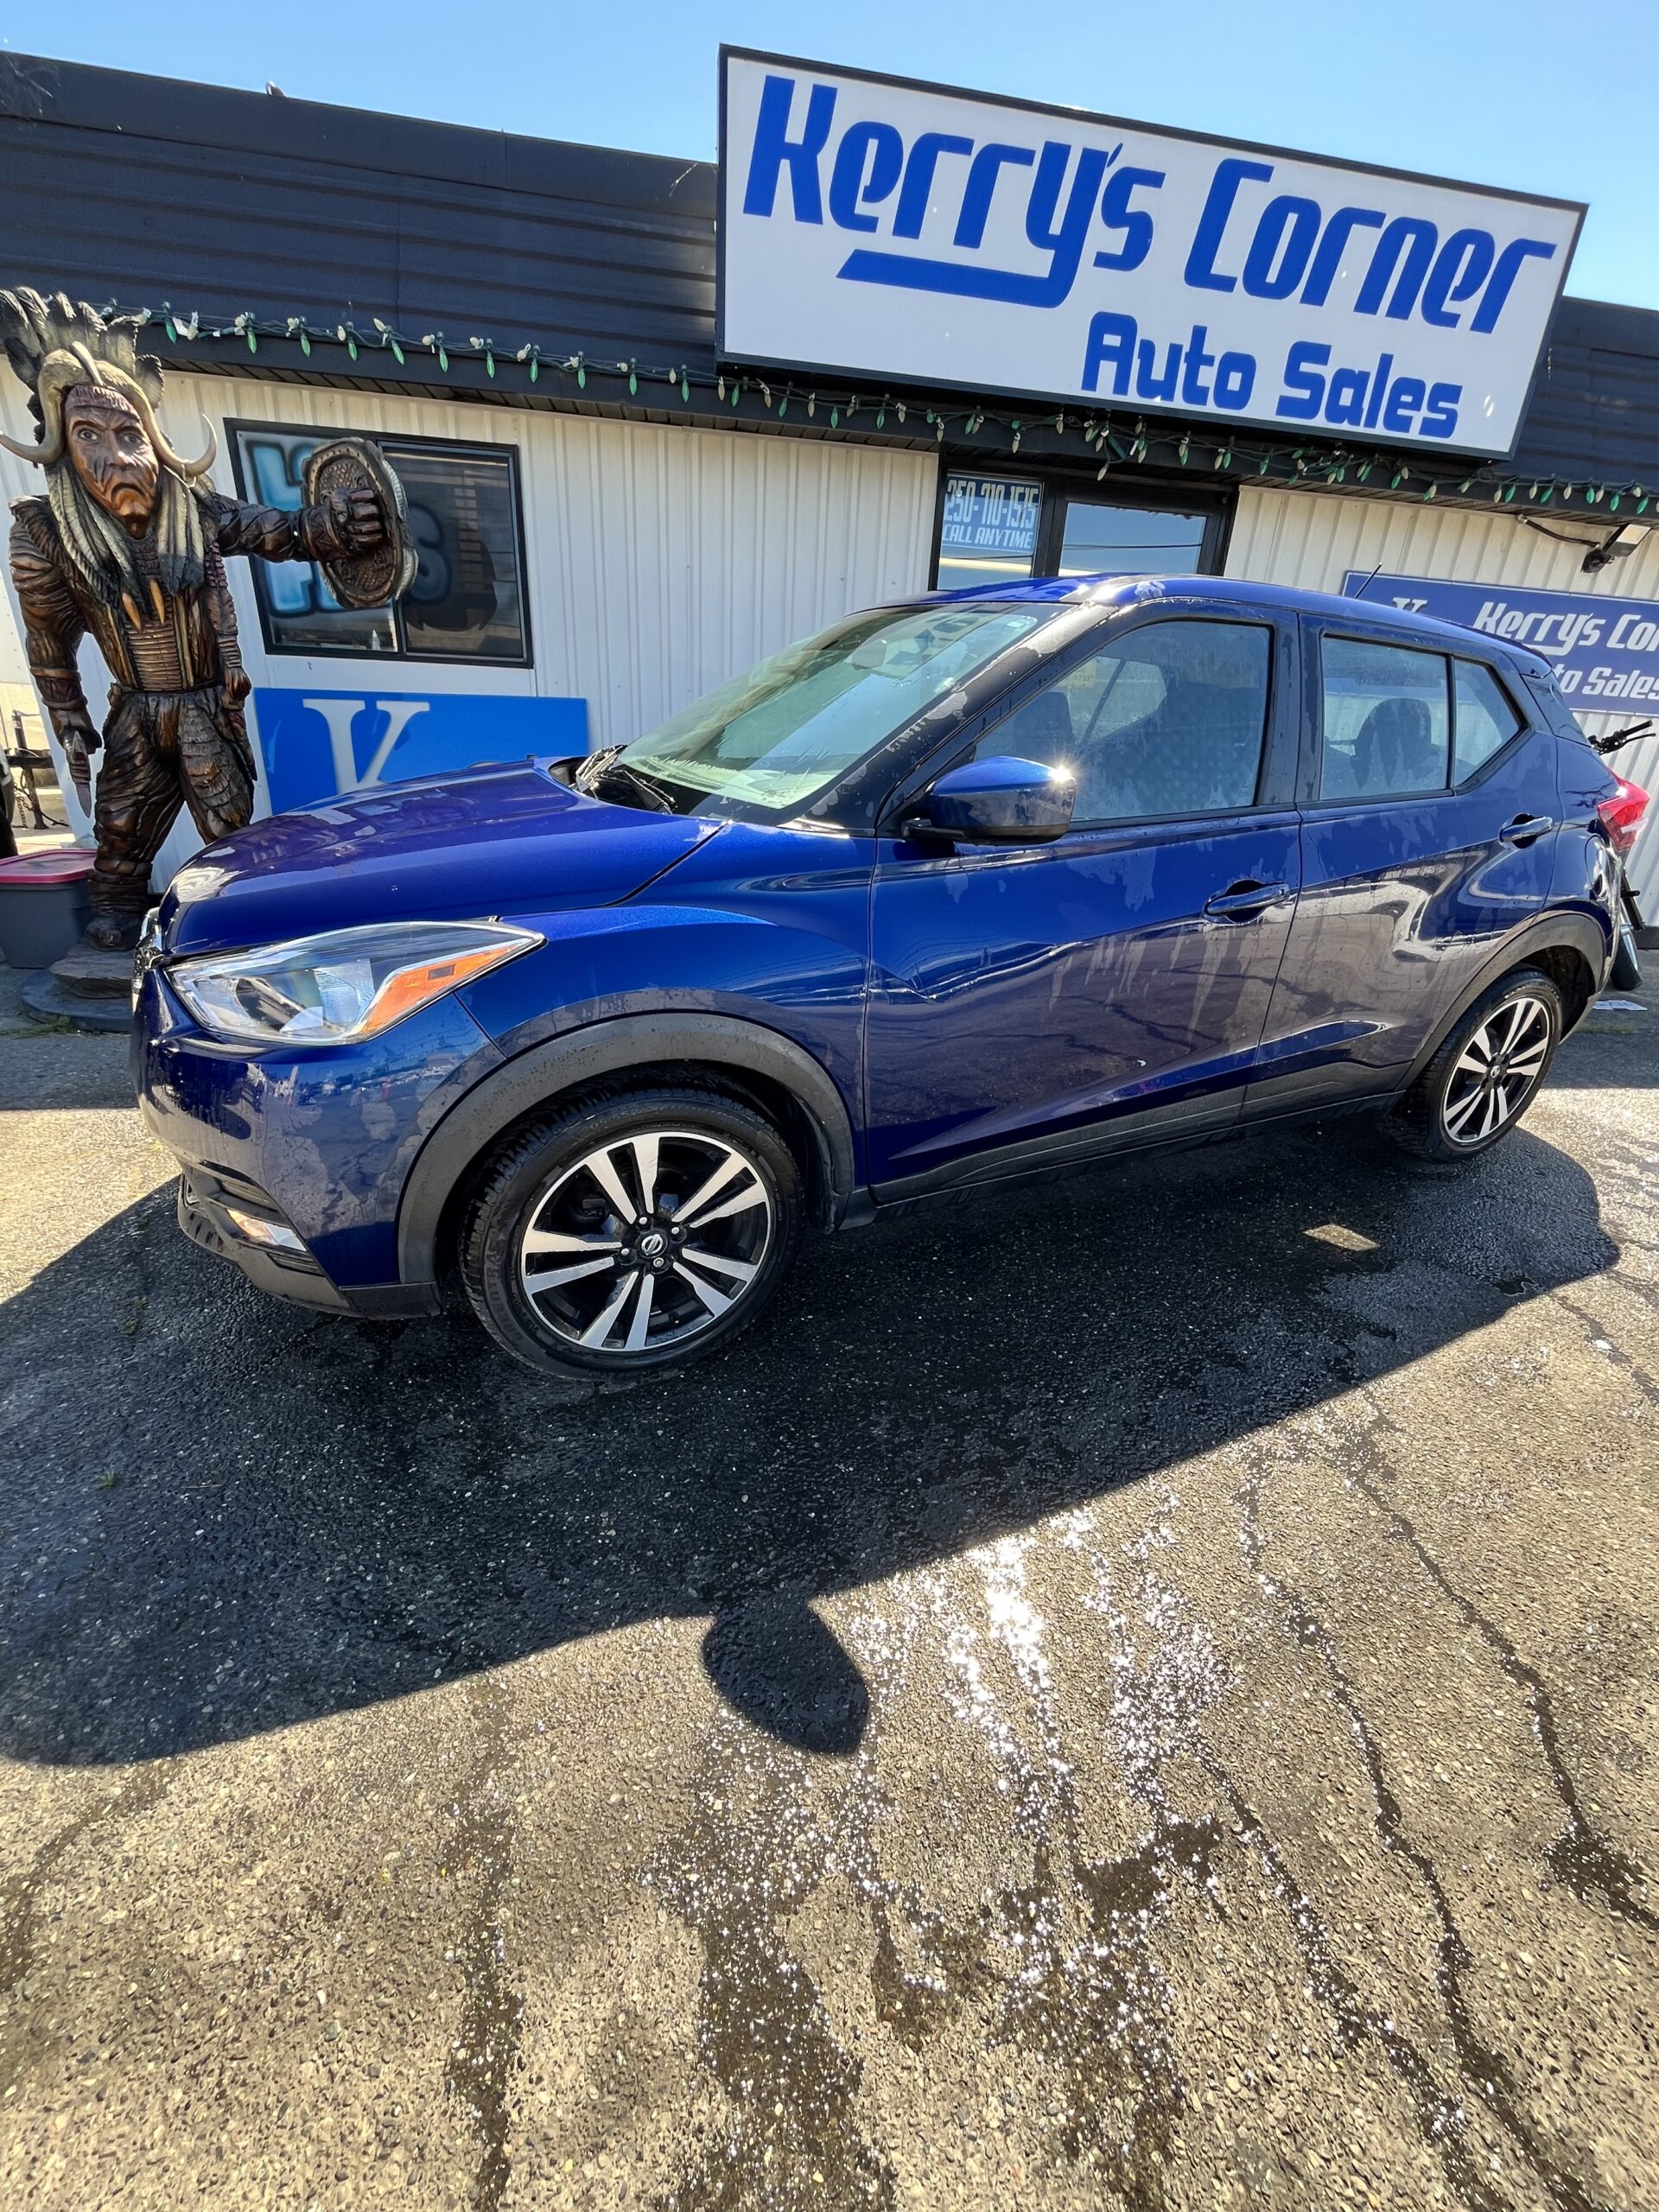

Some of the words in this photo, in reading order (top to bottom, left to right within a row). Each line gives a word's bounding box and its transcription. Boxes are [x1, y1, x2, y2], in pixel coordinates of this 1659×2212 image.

[744, 75, 1166, 308] Kerry's
[1185, 158, 1556, 334] Corner
[1081, 311, 1257, 410] Auto
[1275, 340, 1463, 439] Sales
[942, 524, 972, 543] CALL
[975, 526, 1034, 549] ANYTIME
[1471, 601, 1606, 657] Kerry's
[1554, 664, 1583, 694] to
[1581, 666, 1659, 701] Sales
